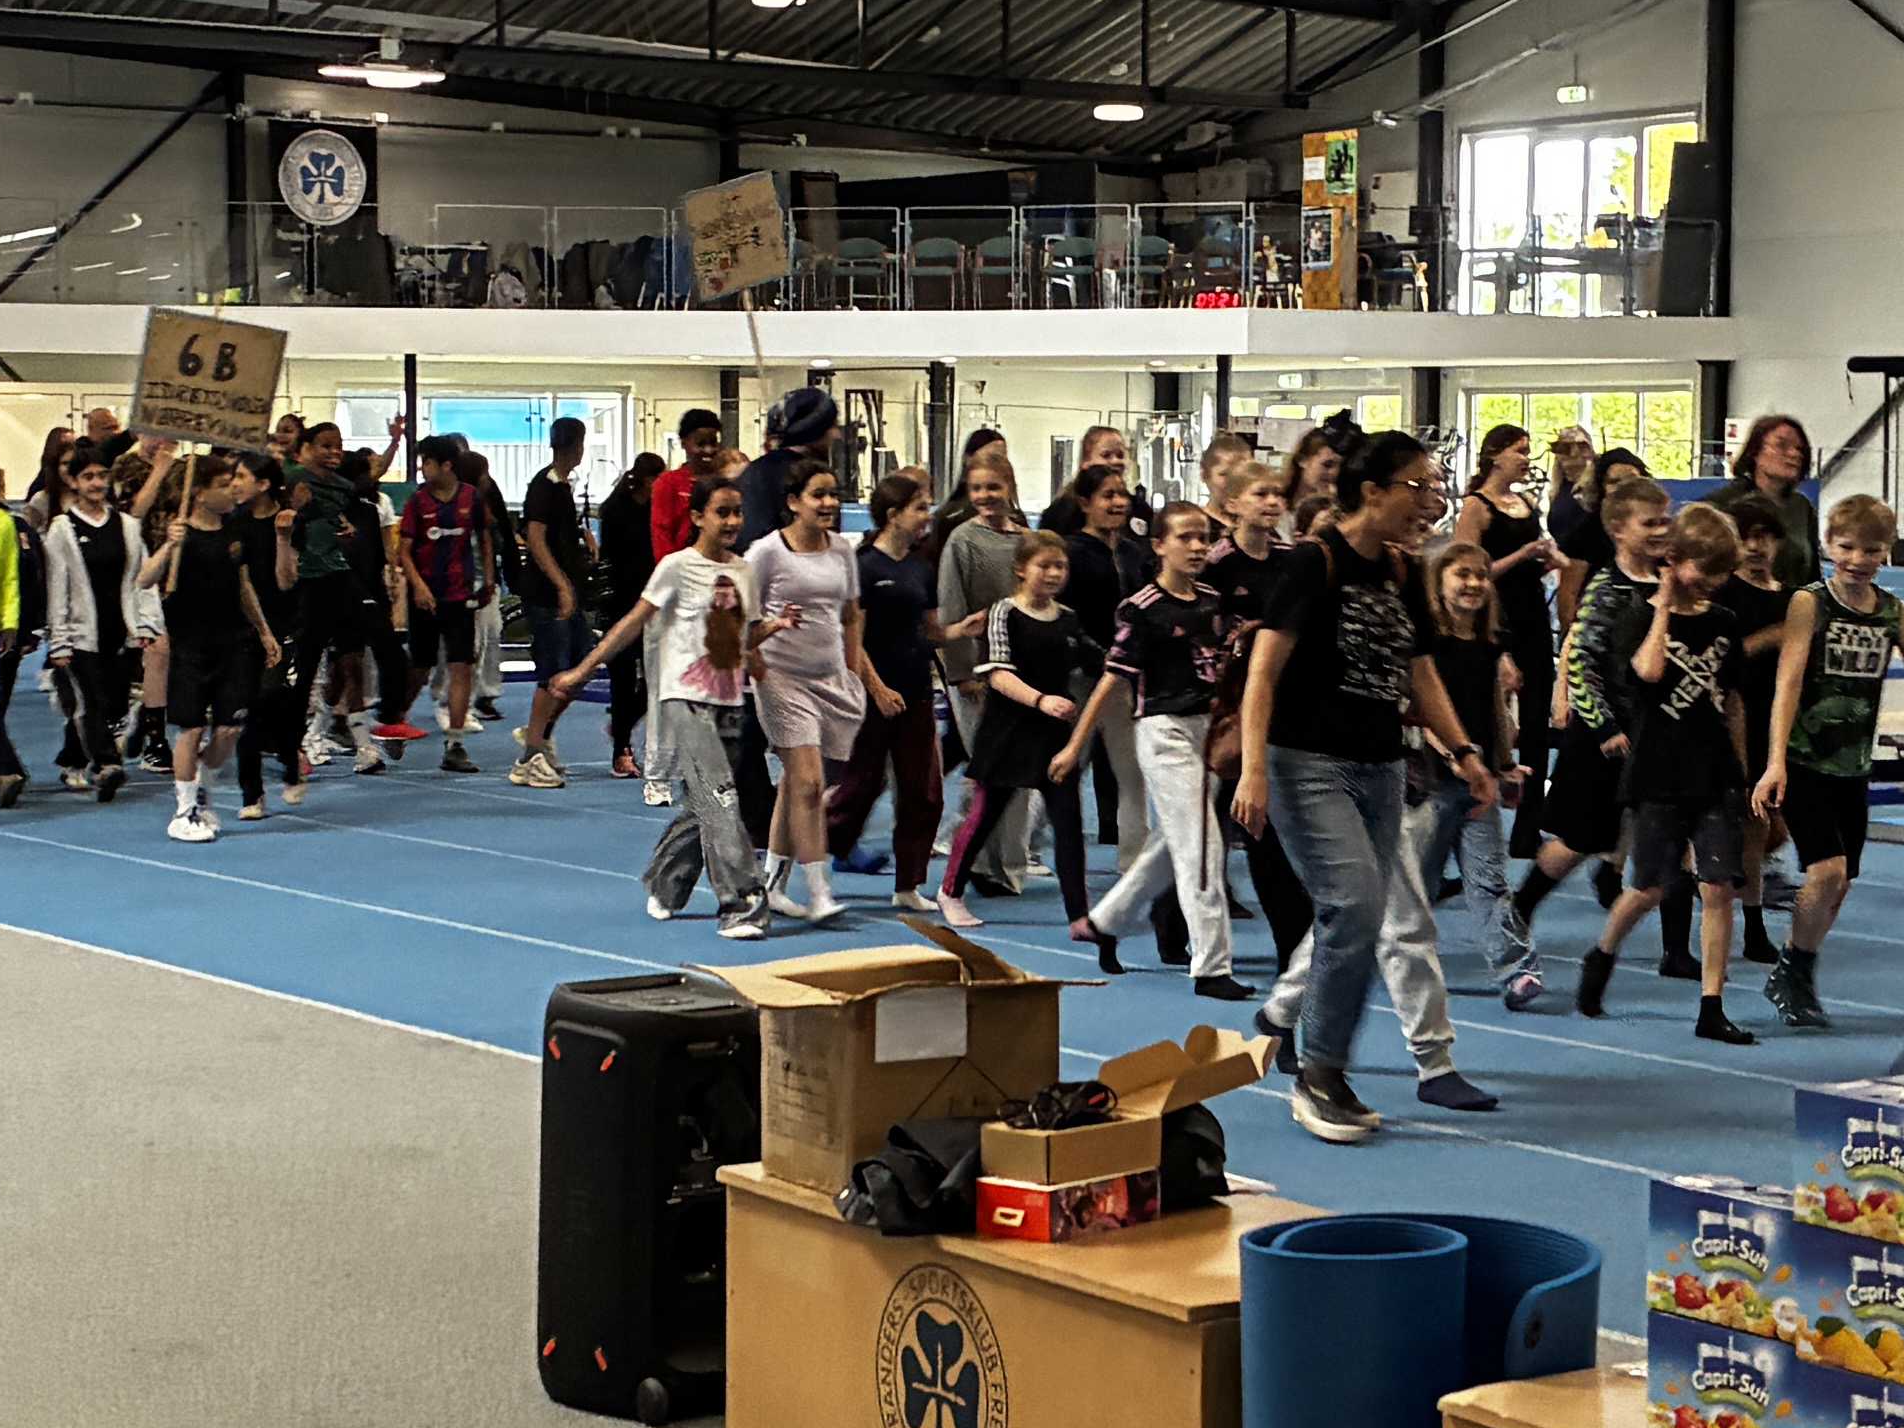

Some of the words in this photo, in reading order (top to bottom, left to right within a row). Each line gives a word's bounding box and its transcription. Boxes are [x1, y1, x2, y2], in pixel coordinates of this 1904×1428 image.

[1692, 1236, 1769, 1272] Capri-Sun
[879, 1303, 905, 1428] RANDERS
[907, 1270, 1000, 1369] SPORTSKLUB
[1692, 1368, 1770, 1406] Capri-Sun
